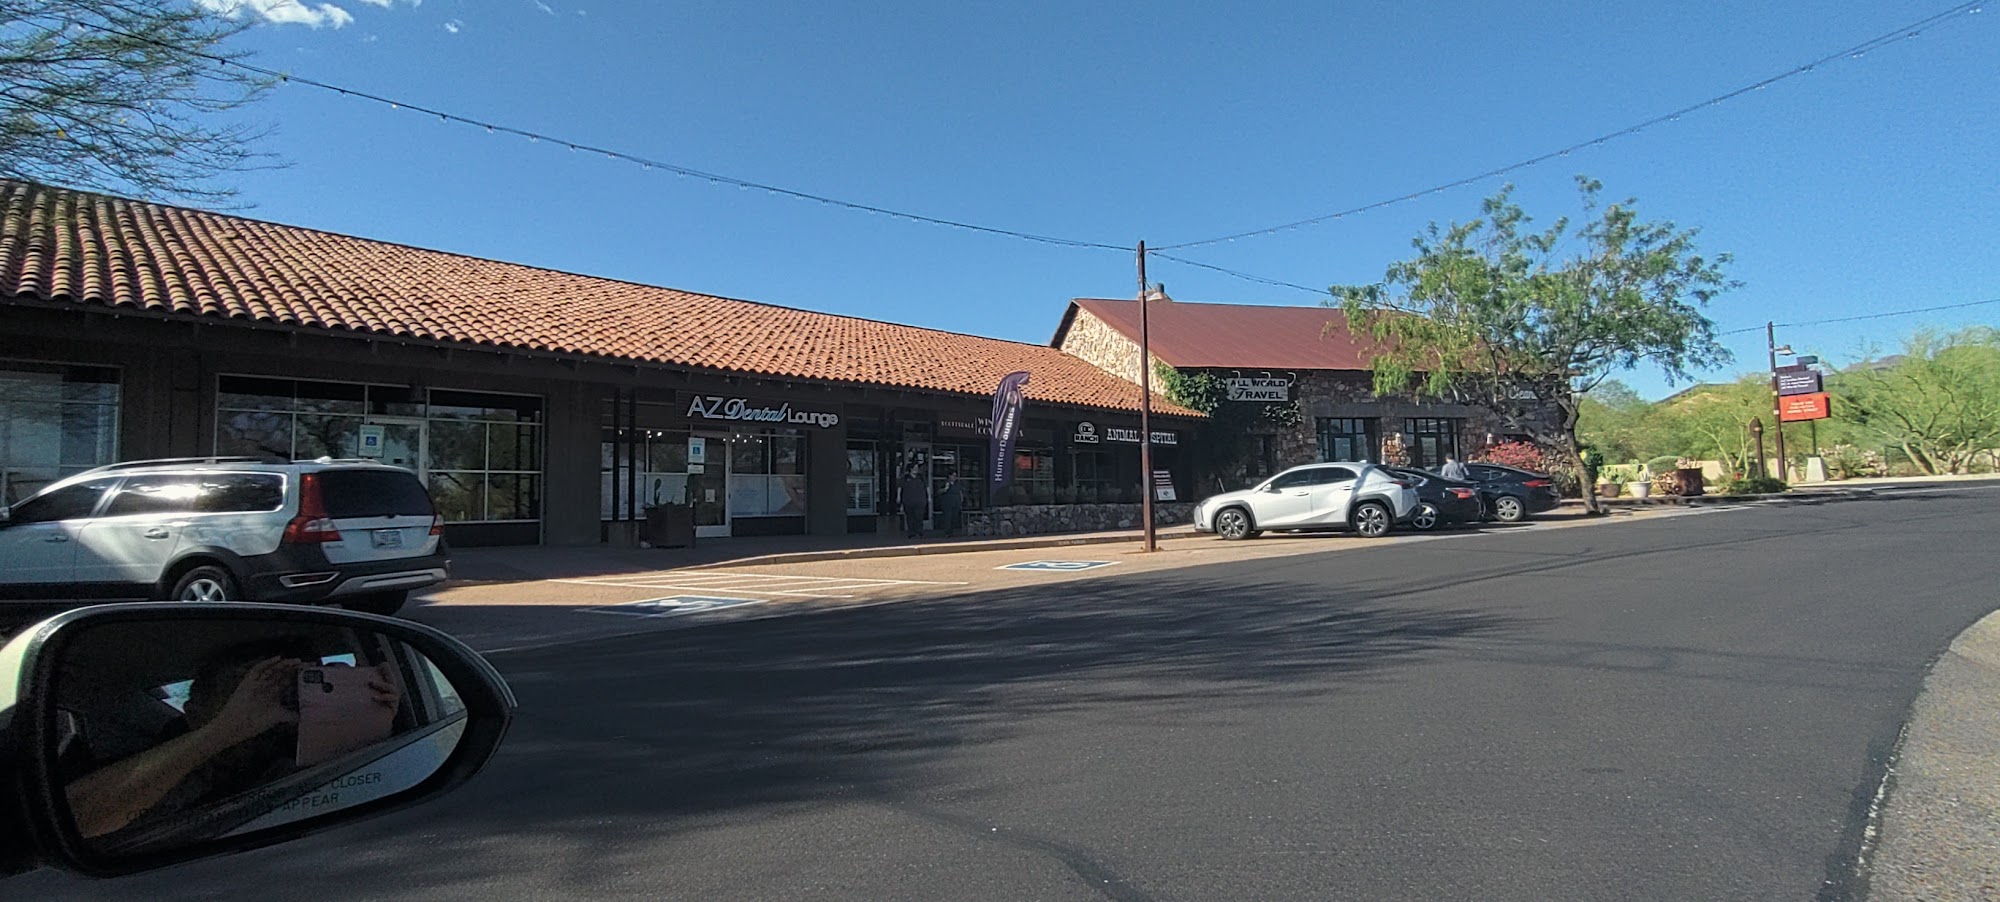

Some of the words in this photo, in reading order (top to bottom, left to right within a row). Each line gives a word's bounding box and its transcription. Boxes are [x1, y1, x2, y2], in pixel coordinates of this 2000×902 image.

[1234, 388, 1284, 400] TRAVEL
[687, 395, 724, 419] AZ
[724, 399, 788, 422] Dental
[787, 407, 839, 428] Lounge
[994, 406, 1016, 482] HunterDouglas
[1075, 435, 1098, 443] RANCH
[1106, 428, 1140, 442] ANIMAL
[1142, 431, 1177, 445] SPITAL
[331, 772, 382, 790] CLOSER
[281, 792, 340, 812] APPEAR
